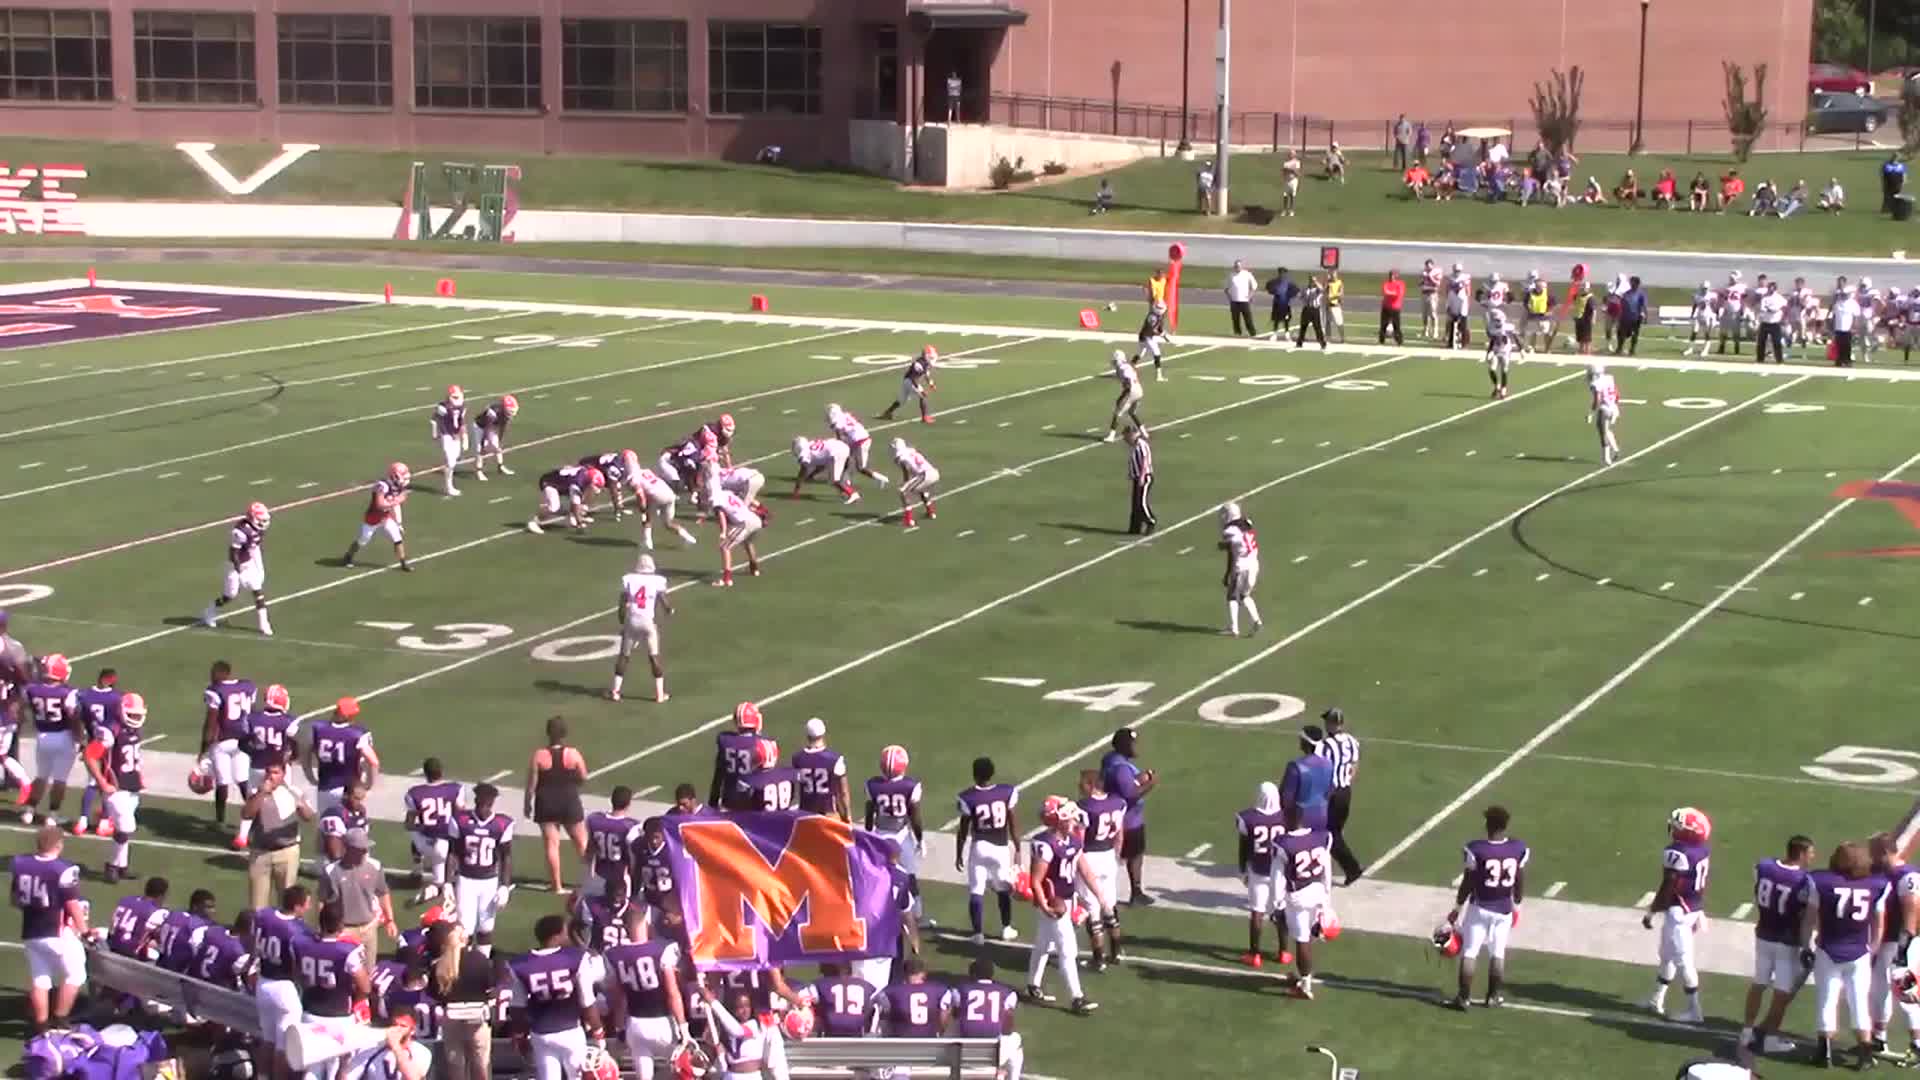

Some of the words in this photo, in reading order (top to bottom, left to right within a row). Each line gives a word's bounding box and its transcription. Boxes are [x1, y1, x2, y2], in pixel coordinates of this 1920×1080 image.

[634, 586, 648, 610] 4
[1043, 681, 1305, 725] 40
[1799, 745, 1919, 784] 5
[420, 797, 452, 826] 24
[678, 817, 868, 962] M
[1484, 858, 1517, 888] 33
[18, 873, 50, 908] 94
[1757, 878, 1792, 916] 87
[1833, 886, 1871, 921] 75
[301, 956, 337, 990] 95
[528, 967, 574, 1000] 55
[618, 955, 660, 992] 48
[909, 991, 929, 1025] 6
[966, 989, 1002, 1023] 21
